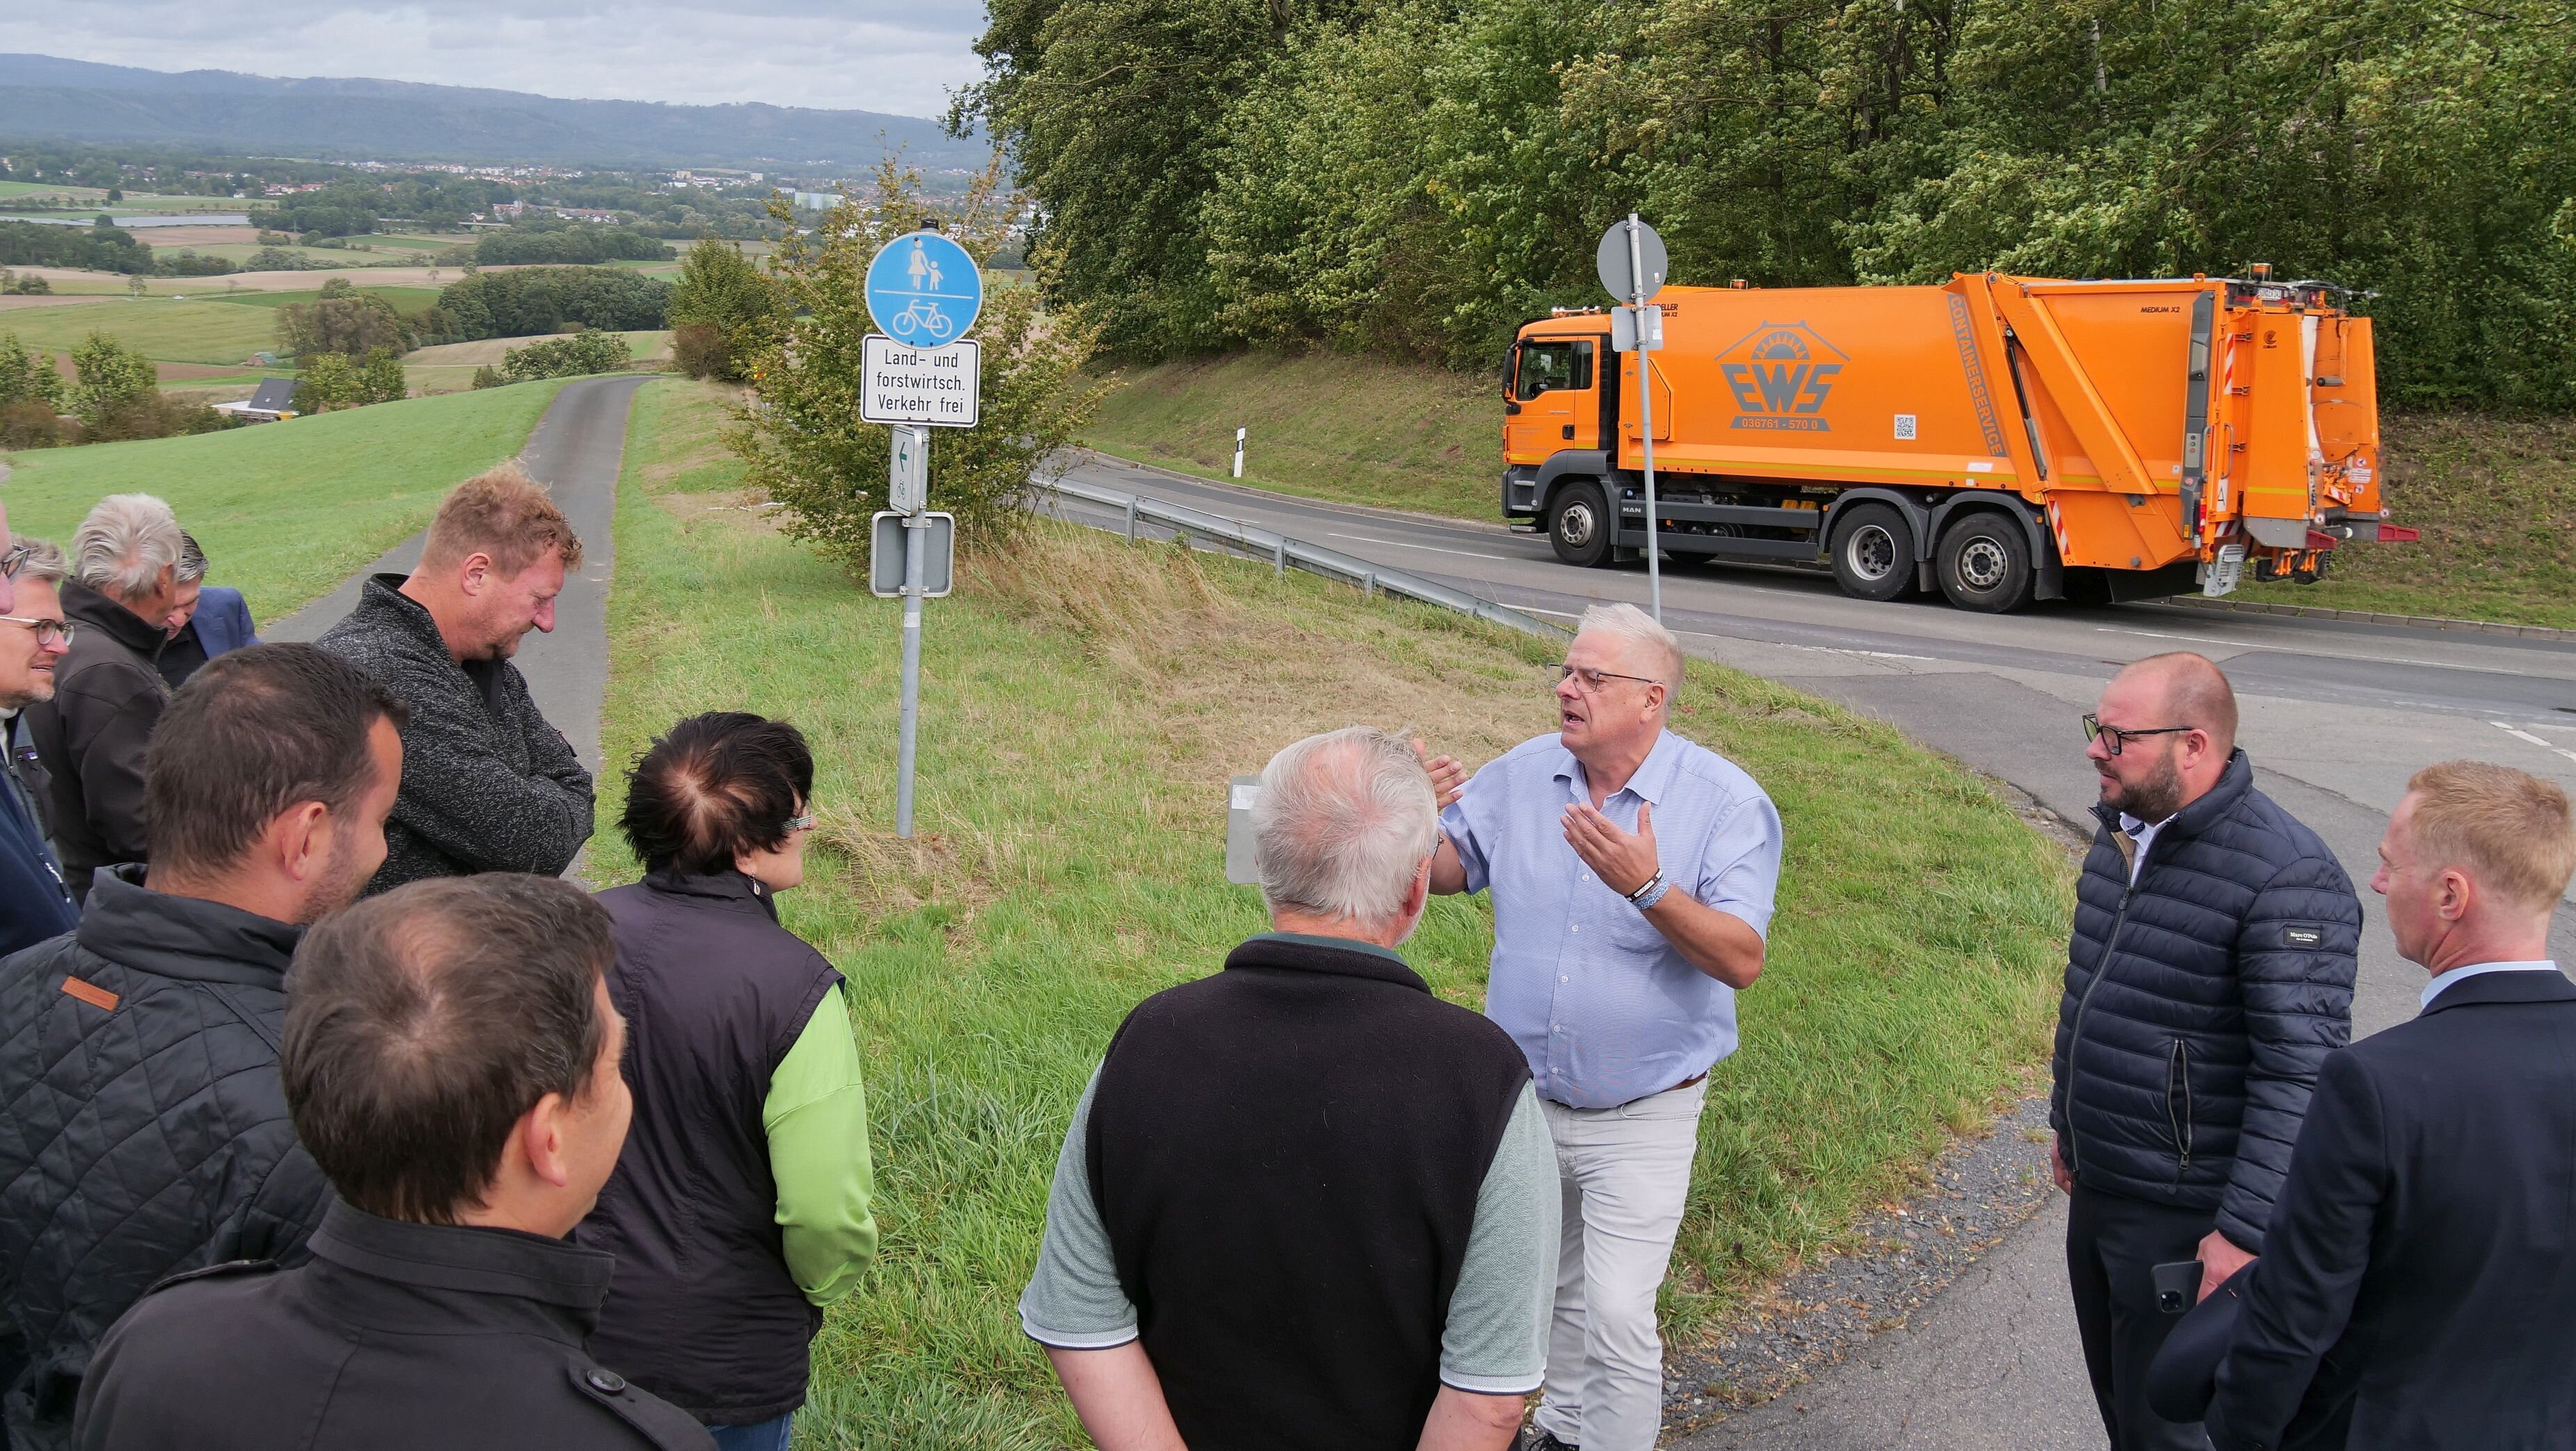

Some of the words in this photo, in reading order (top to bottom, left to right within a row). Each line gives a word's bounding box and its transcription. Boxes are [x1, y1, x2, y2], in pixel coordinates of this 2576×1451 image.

[885, 349, 926, 366] Land-
[934, 353, 958, 368] und
[876, 371, 965, 391] forstwirtsch.
[1949, 296, 2003, 456] CONTAINERSERVICE
[1719, 363, 1843, 413] EWS
[878, 394, 932, 412] Verkehr
[940, 396, 963, 413] frei
[1742, 418, 1779, 428] 036761
[1789, 419, 1808, 429] 570
[2217, 486, 2225, 506] A
